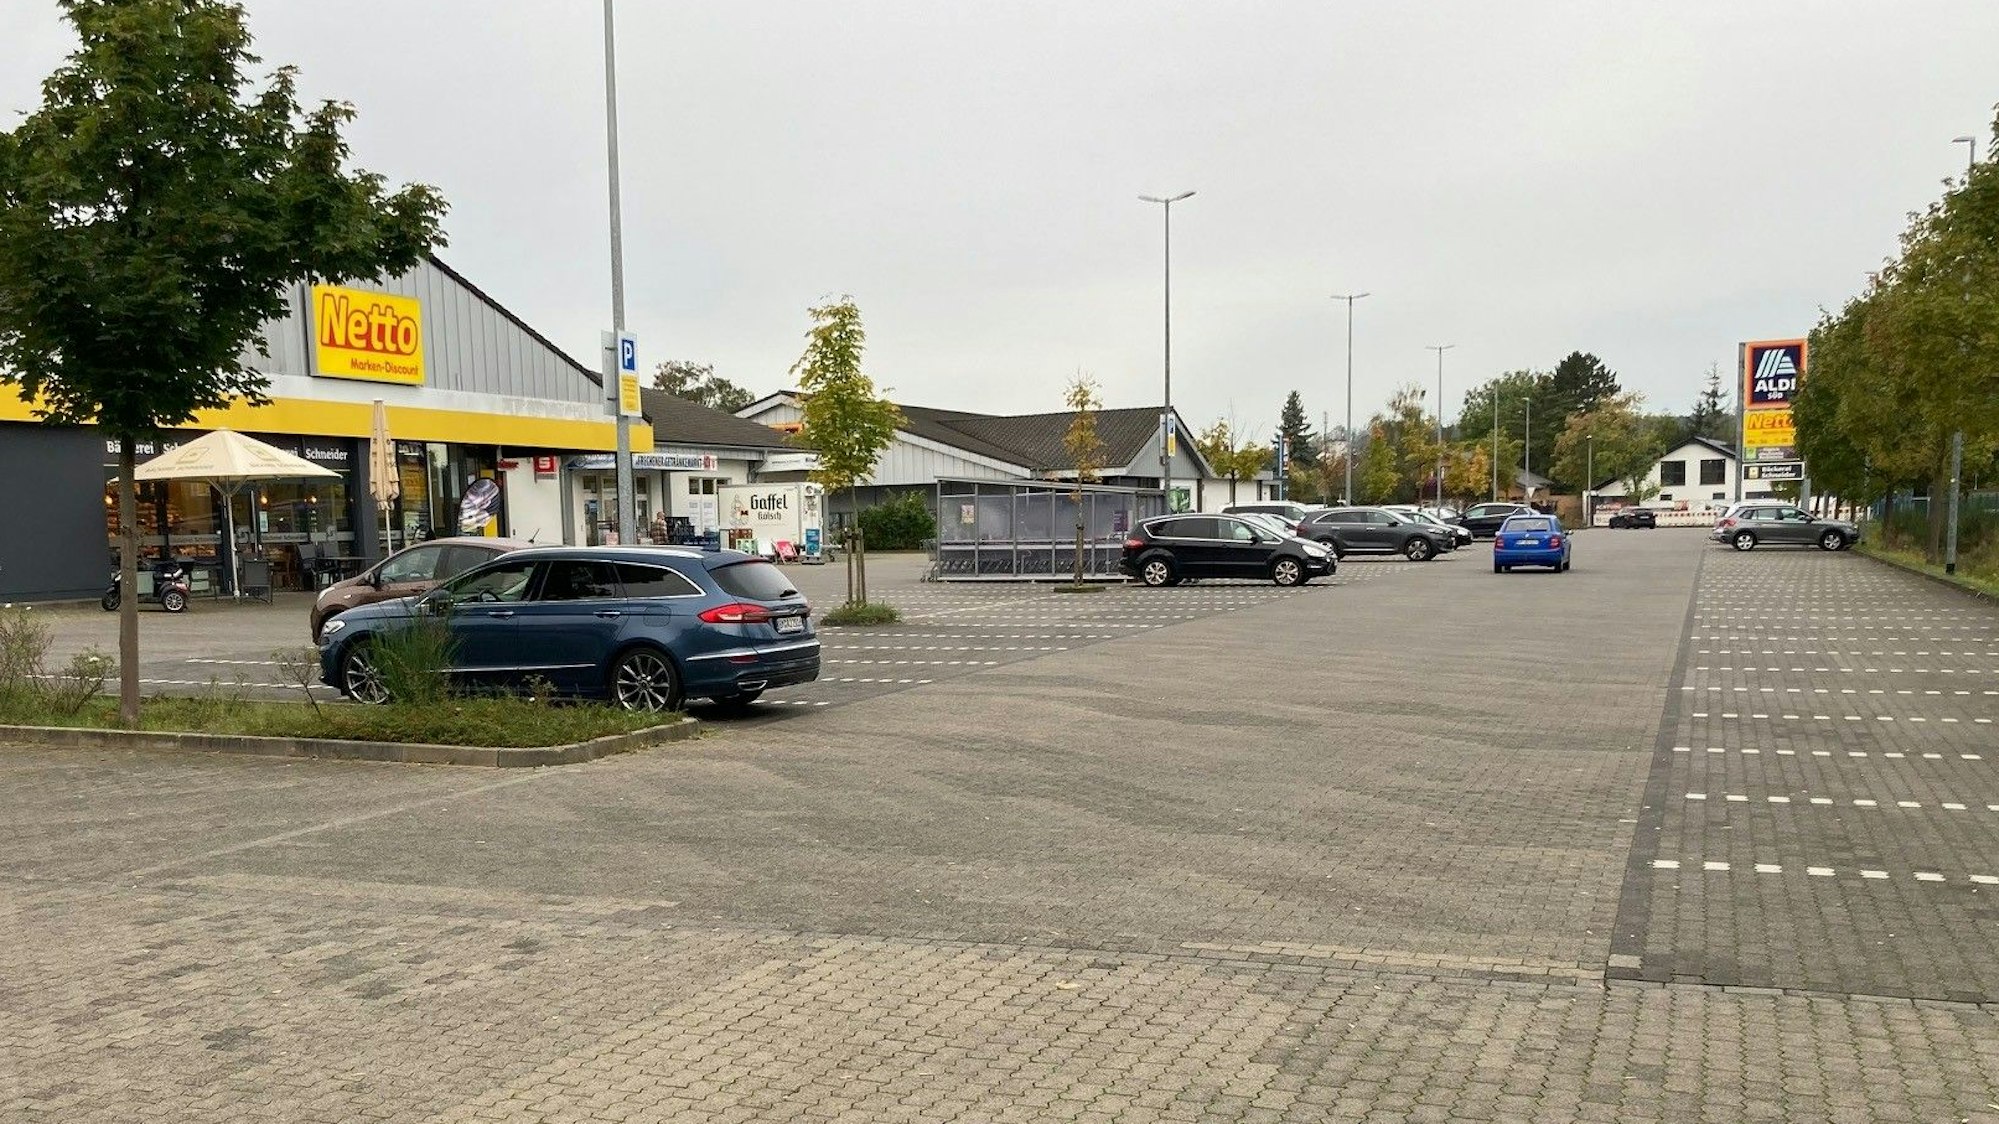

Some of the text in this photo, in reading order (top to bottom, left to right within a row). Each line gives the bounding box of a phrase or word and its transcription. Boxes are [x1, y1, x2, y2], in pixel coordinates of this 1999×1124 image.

[321, 293, 418, 356] Netto
[351, 358, 419, 375] Marken-Discount
[1754, 379, 1796, 392] ALDI
[1749, 412, 1793, 429] Nett
[105, 440, 155, 455] Bäerei
[305, 447, 348, 461] Schneider
[751, 493, 788, 511] Gaffel
